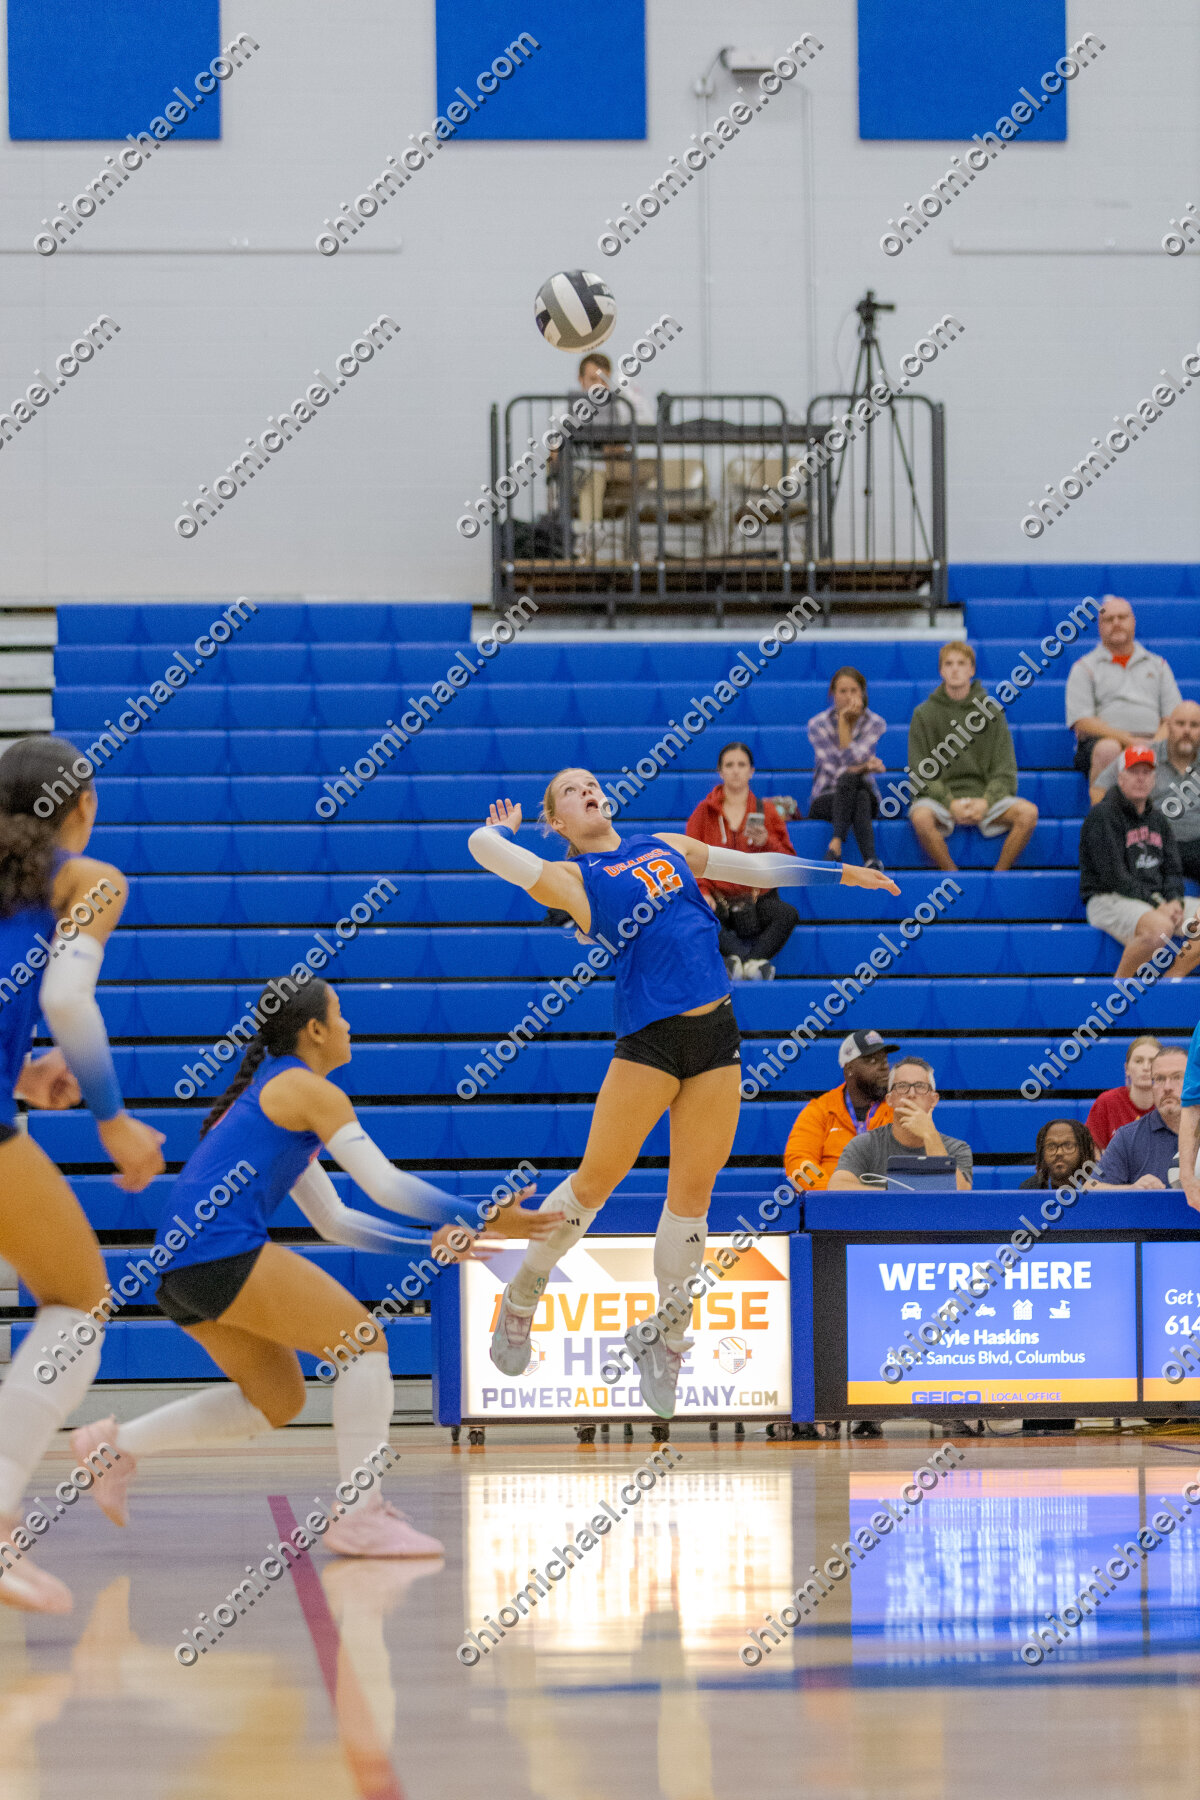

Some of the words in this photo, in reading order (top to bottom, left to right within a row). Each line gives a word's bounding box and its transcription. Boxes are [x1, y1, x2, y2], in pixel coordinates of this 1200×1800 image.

[632, 859, 683, 900] 12
[878, 1262, 990, 1291] WE'RE
[1004, 1261, 1092, 1290] HERE
[1165, 1288, 1194, 1305] Get
[488, 1291, 769, 1332] DVERISE
[973, 1328, 1040, 1345] Haskins
[886, 1351, 924, 1366] 851
[926, 1351, 976, 1365] Sancus
[978, 1350, 1013, 1366] Blvd,
[1015, 1349, 1086, 1364] Columbus
[911, 1390, 982, 1404] GEICO
[991, 1391, 1025, 1402] LOCAL
[1028, 1391, 1062, 1401] OFFICE
